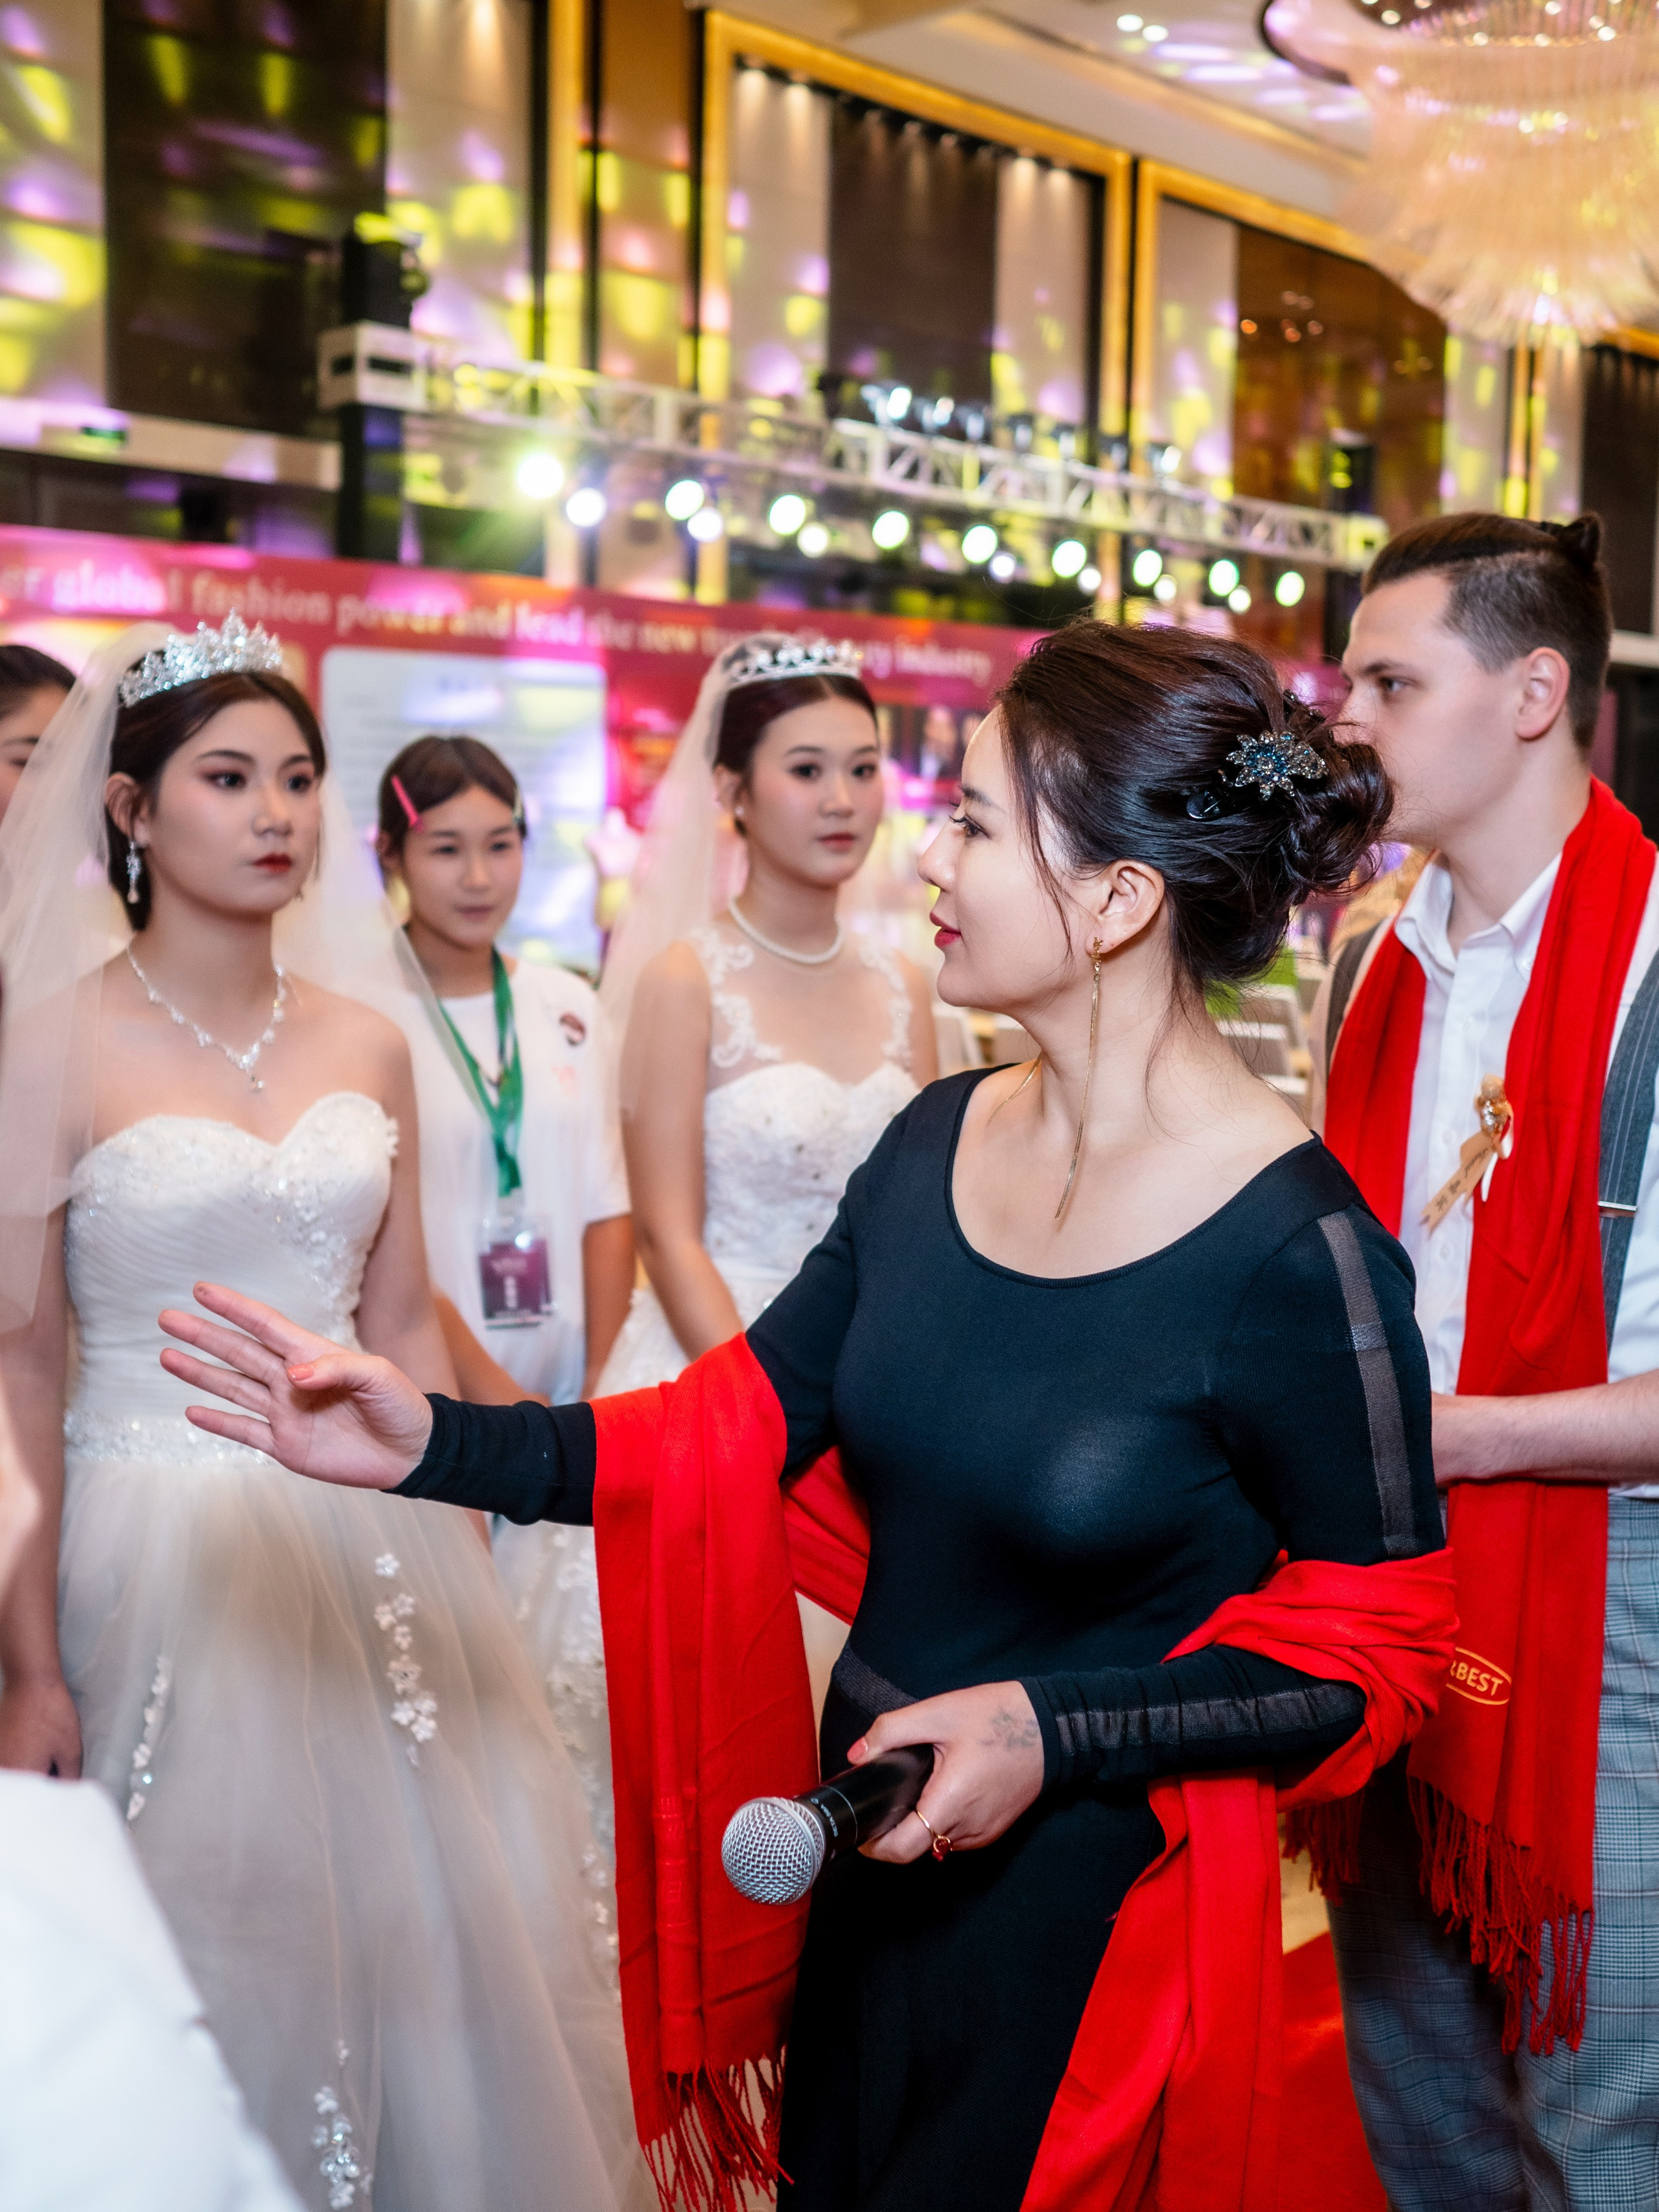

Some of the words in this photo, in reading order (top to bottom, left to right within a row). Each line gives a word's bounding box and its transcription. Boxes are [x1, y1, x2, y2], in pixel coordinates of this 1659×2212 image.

[52, 559, 184, 613] global
[192, 570, 331, 626] fashion
[336, 592, 443, 636] power
[448, 599, 512, 640] and
[516, 600, 583, 647] lead
[638, 622, 697, 655] new
[830, 1817, 838, 1837] BETA
